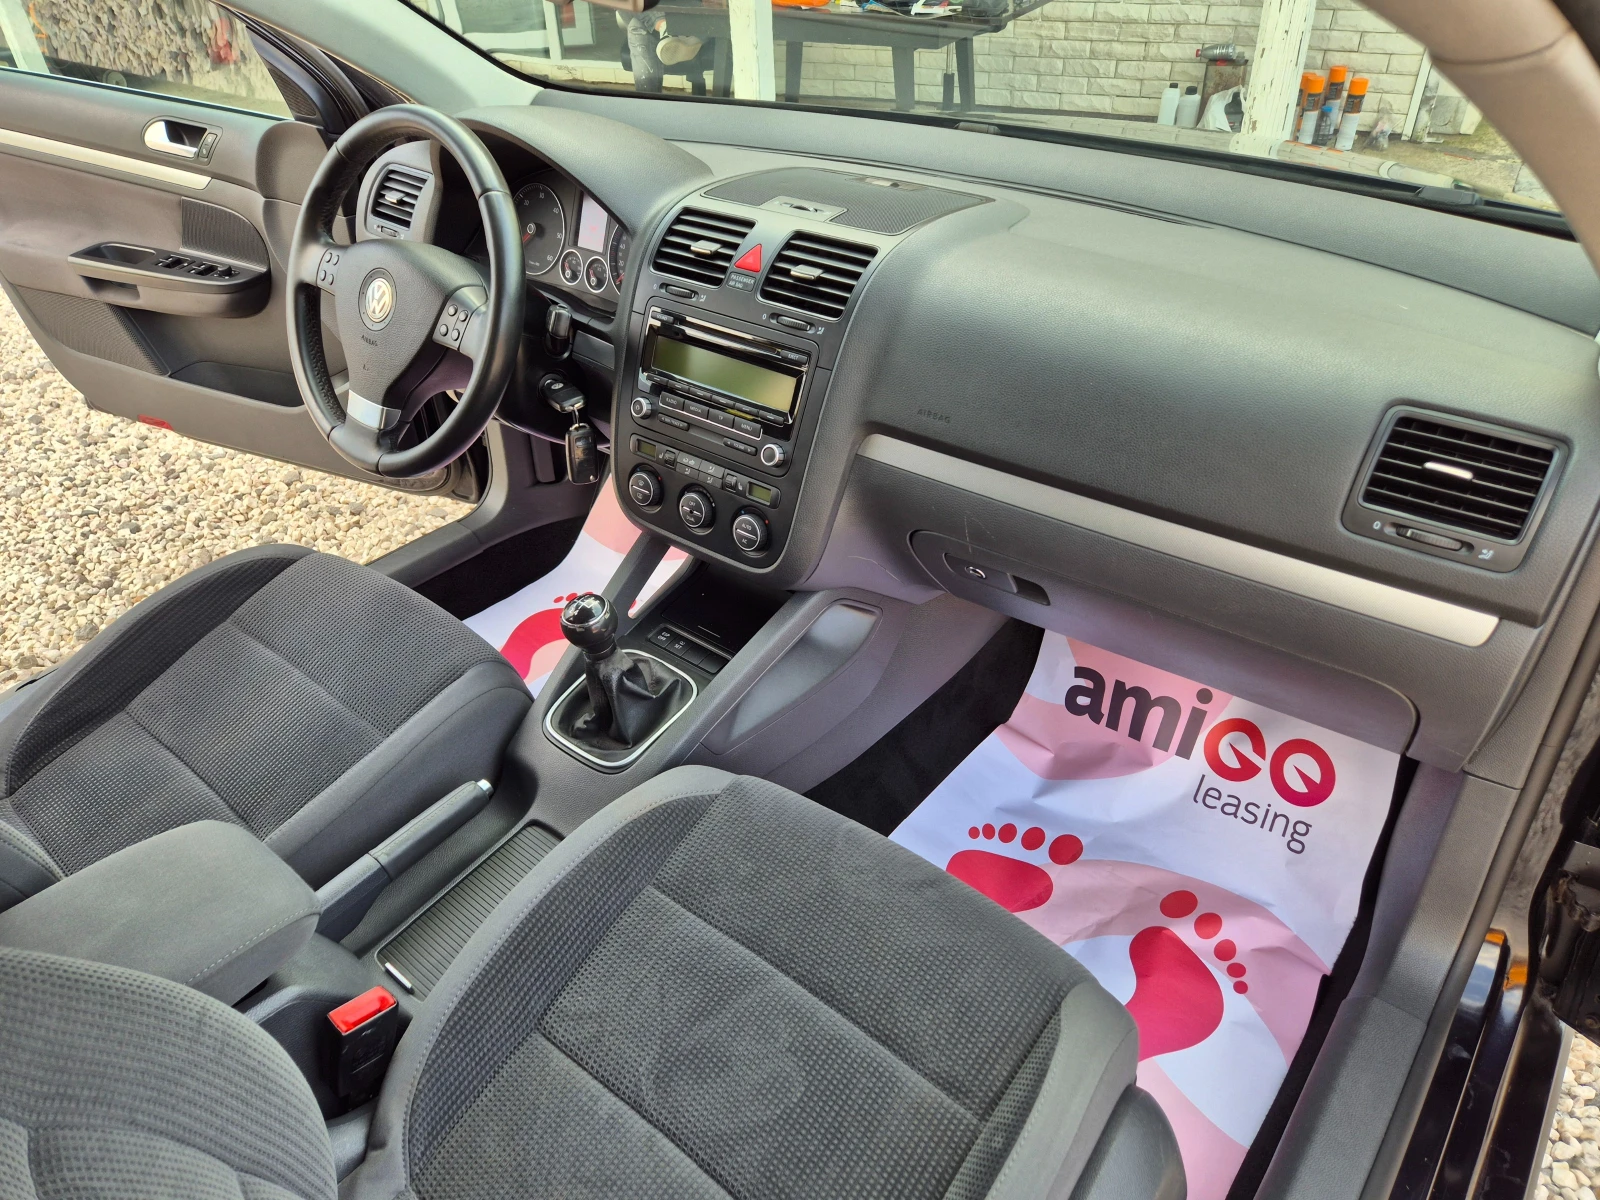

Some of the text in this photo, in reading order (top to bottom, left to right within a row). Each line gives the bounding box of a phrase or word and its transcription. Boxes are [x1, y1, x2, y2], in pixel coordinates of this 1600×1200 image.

[730, 274, 755, 285] PASSENGER
[361, 334, 378, 347] AIRBAG
[665, 397, 678, 405] RADIO
[689, 405, 702, 413] MEDIA
[917, 409, 950, 424] AIRBAG
[740, 423, 753, 432] MENU
[1064, 666, 1336, 807] amiGO
[1192, 774, 1312, 855] leasing
